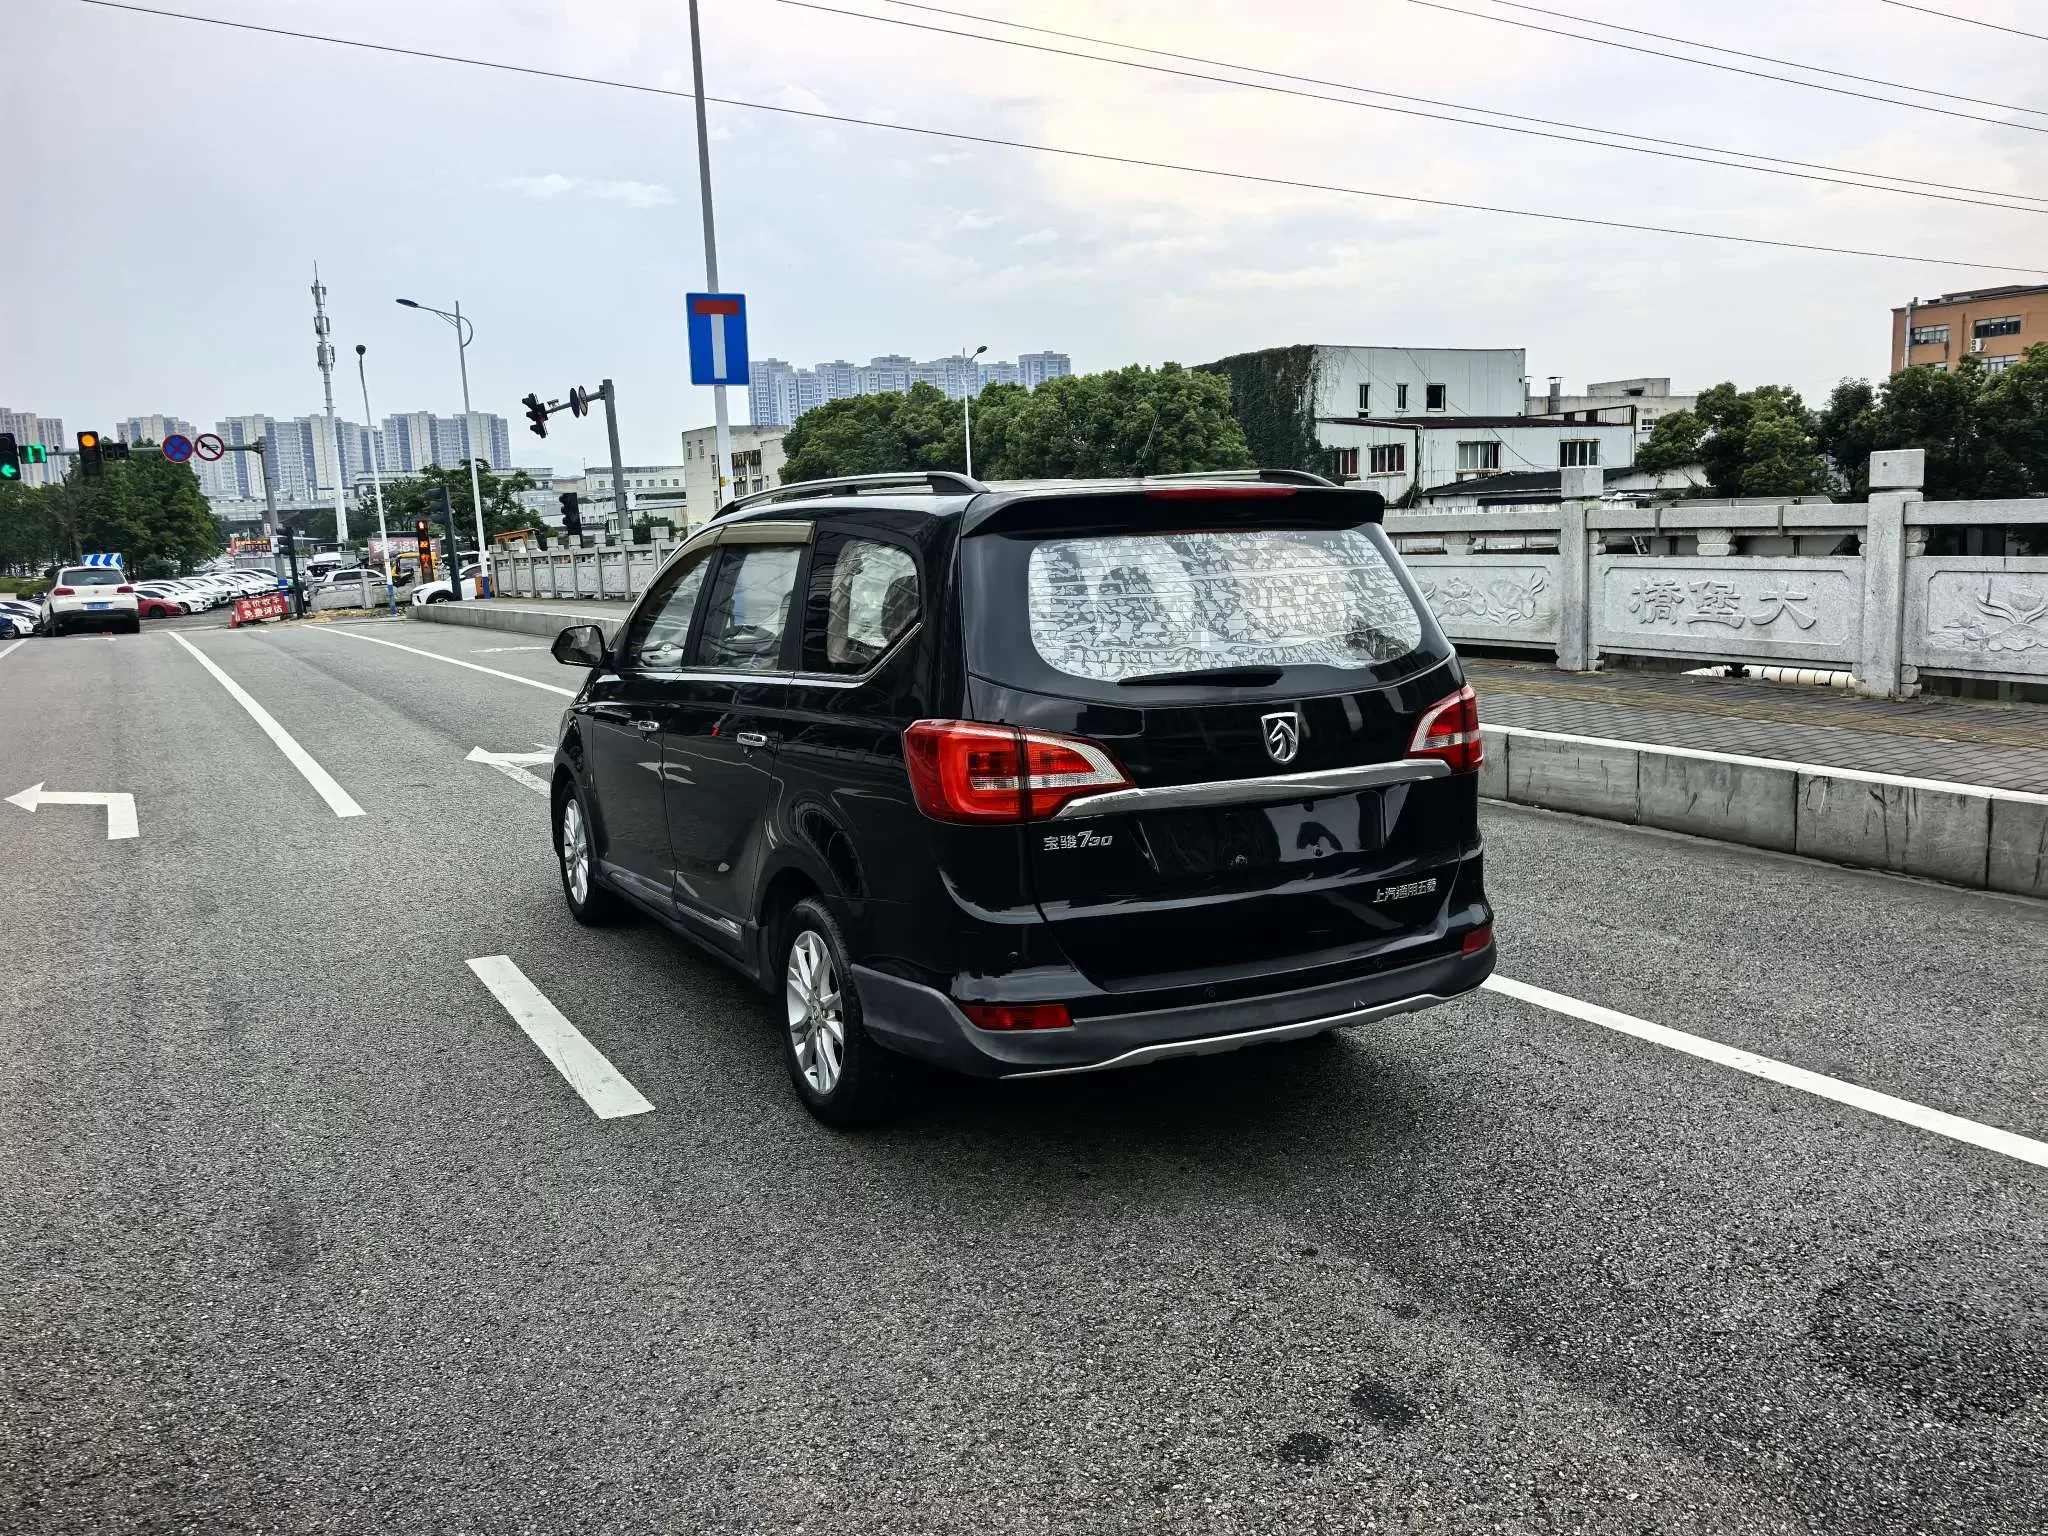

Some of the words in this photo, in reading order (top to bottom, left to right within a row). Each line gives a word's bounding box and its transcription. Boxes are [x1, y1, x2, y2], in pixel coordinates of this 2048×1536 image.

[1372, 878, 1437, 904] 上汽通用五菱
